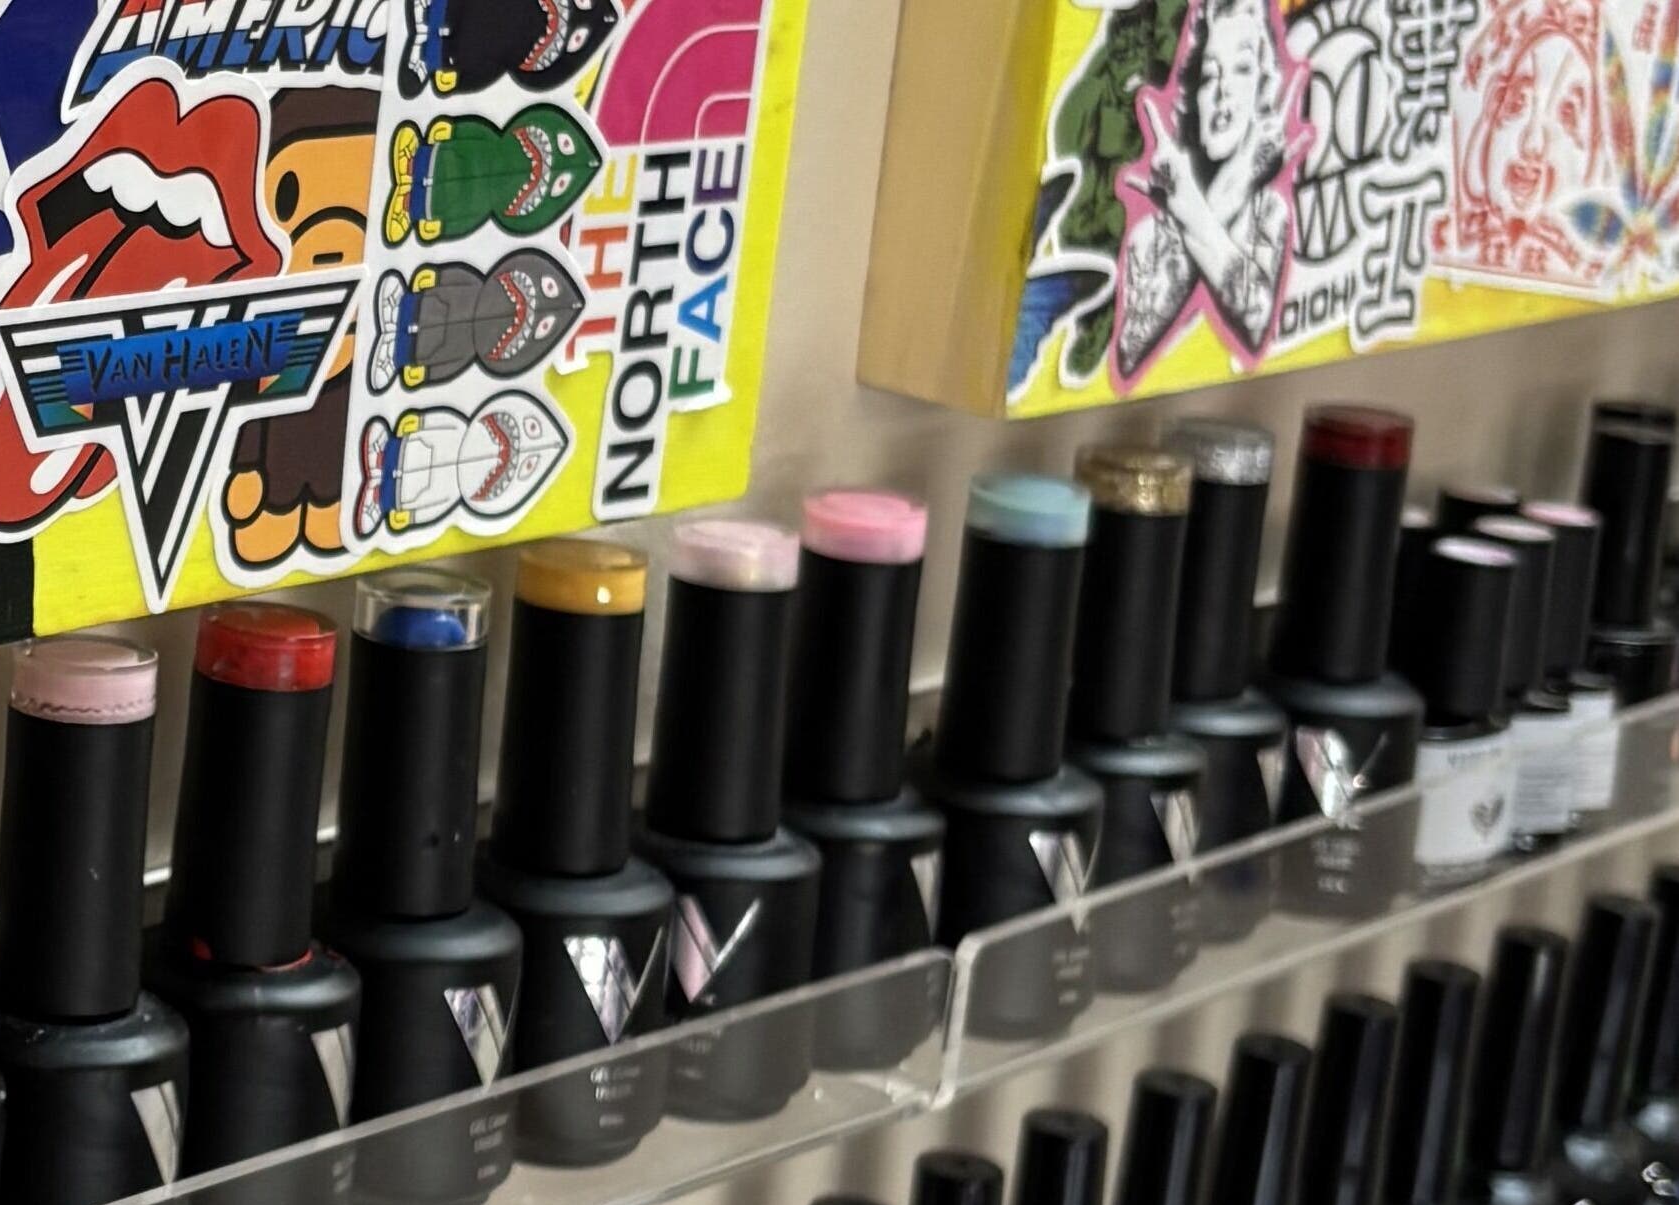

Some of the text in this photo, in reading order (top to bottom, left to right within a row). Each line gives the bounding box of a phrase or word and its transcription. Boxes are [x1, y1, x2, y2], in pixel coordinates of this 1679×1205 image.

[86, 320, 274, 395] VAN HALEN
[564, 152, 638, 362] THE
[601, 150, 692, 506] NORTH
[667, 143, 745, 401] FACE
